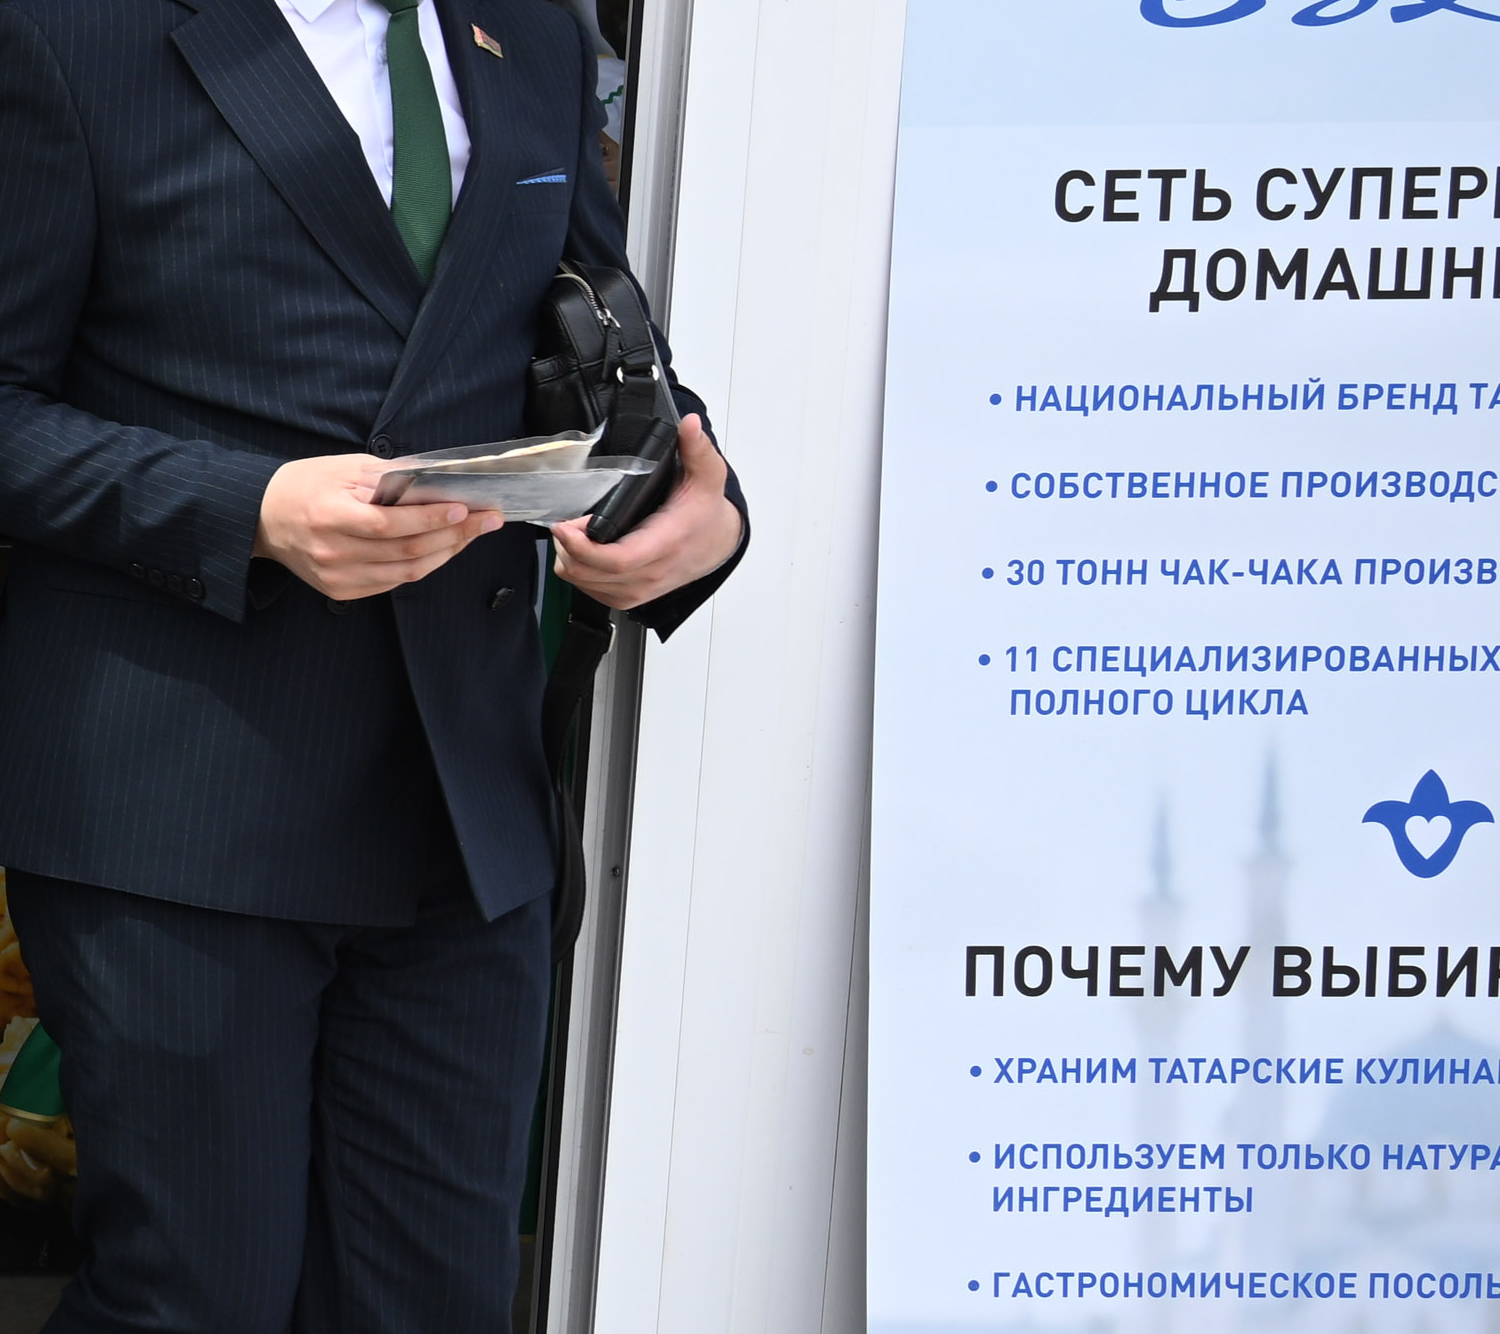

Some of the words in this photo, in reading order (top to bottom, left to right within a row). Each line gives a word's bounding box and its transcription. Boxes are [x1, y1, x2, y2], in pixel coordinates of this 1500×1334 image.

[1055, 169, 1231, 222] СЕТЬ
[1256, 166, 1500, 221] СУПЕР
[1149, 247, 1500, 312] ДОМАШН
[1016, 378, 1324, 416] НАЦИОНАЛЬНЫЙ
[1338, 383, 1457, 415] БРЕНД
[1012, 472, 1269, 498] СОБСТВЕННОЕ
[1007, 560, 1044, 585] 30
[1056, 560, 1147, 585] ТОНН
[1161, 559, 1342, 584] ЧАК-ЧАКА
[1355, 559, 1497, 584] ПРОИЗВ
[1006, 646, 1036, 672] 11
[1053, 646, 1500, 677] СПЕЦИАЛИЗИРОВАННЫХ
[1011, 689, 1173, 715] ПОЛНОГО
[1186, 689, 1308, 720] ЦИКЛА
[966, 946, 1251, 997] ПОЧЕМУ
[994, 1058, 1136, 1083] ХРАНИМ
[1149, 1058, 1343, 1084] ТАТАРСКИЕ
[1356, 1058, 1500, 1084] КУЛИНА
[995, 1144, 1224, 1169] ИСПОЛЬЗУЕМ
[1237, 1144, 1370, 1170] ТОЛЬКО
[994, 1187, 1252, 1217] ИНГРЕДИЕНТЫ
[994, 1272, 1357, 1298] ГАСТРОНОМИЧЕСКОЕ
